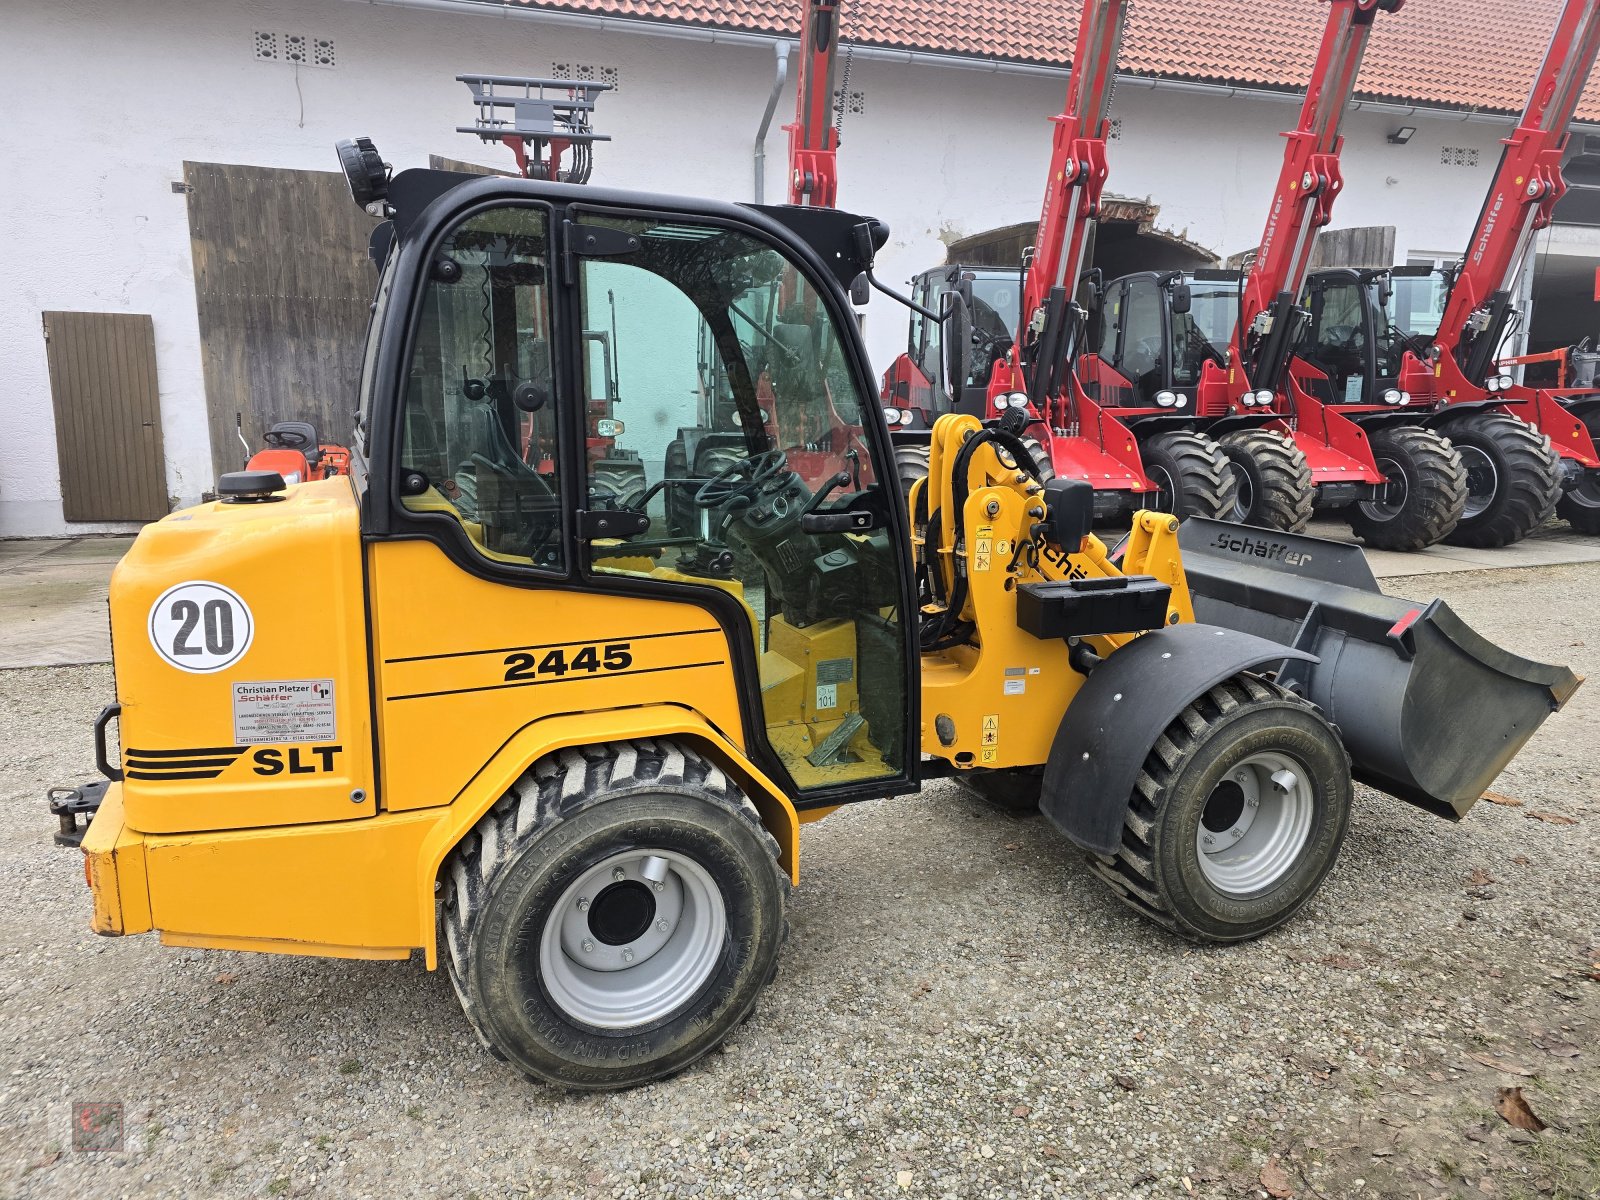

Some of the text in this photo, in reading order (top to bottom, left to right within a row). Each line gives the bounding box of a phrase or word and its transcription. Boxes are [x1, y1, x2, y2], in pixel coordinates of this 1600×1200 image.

[1259, 194, 1283, 272] Schäffer
[1473, 192, 1504, 266] Schäffer
[1210, 533, 1312, 566] Schäffer
[171, 599, 234, 655] 20
[504, 643, 632, 681] 2445
[237, 685, 309, 694] Christian Pletzer
[818, 696, 832, 708] 101
[253, 746, 342, 776] SLT
